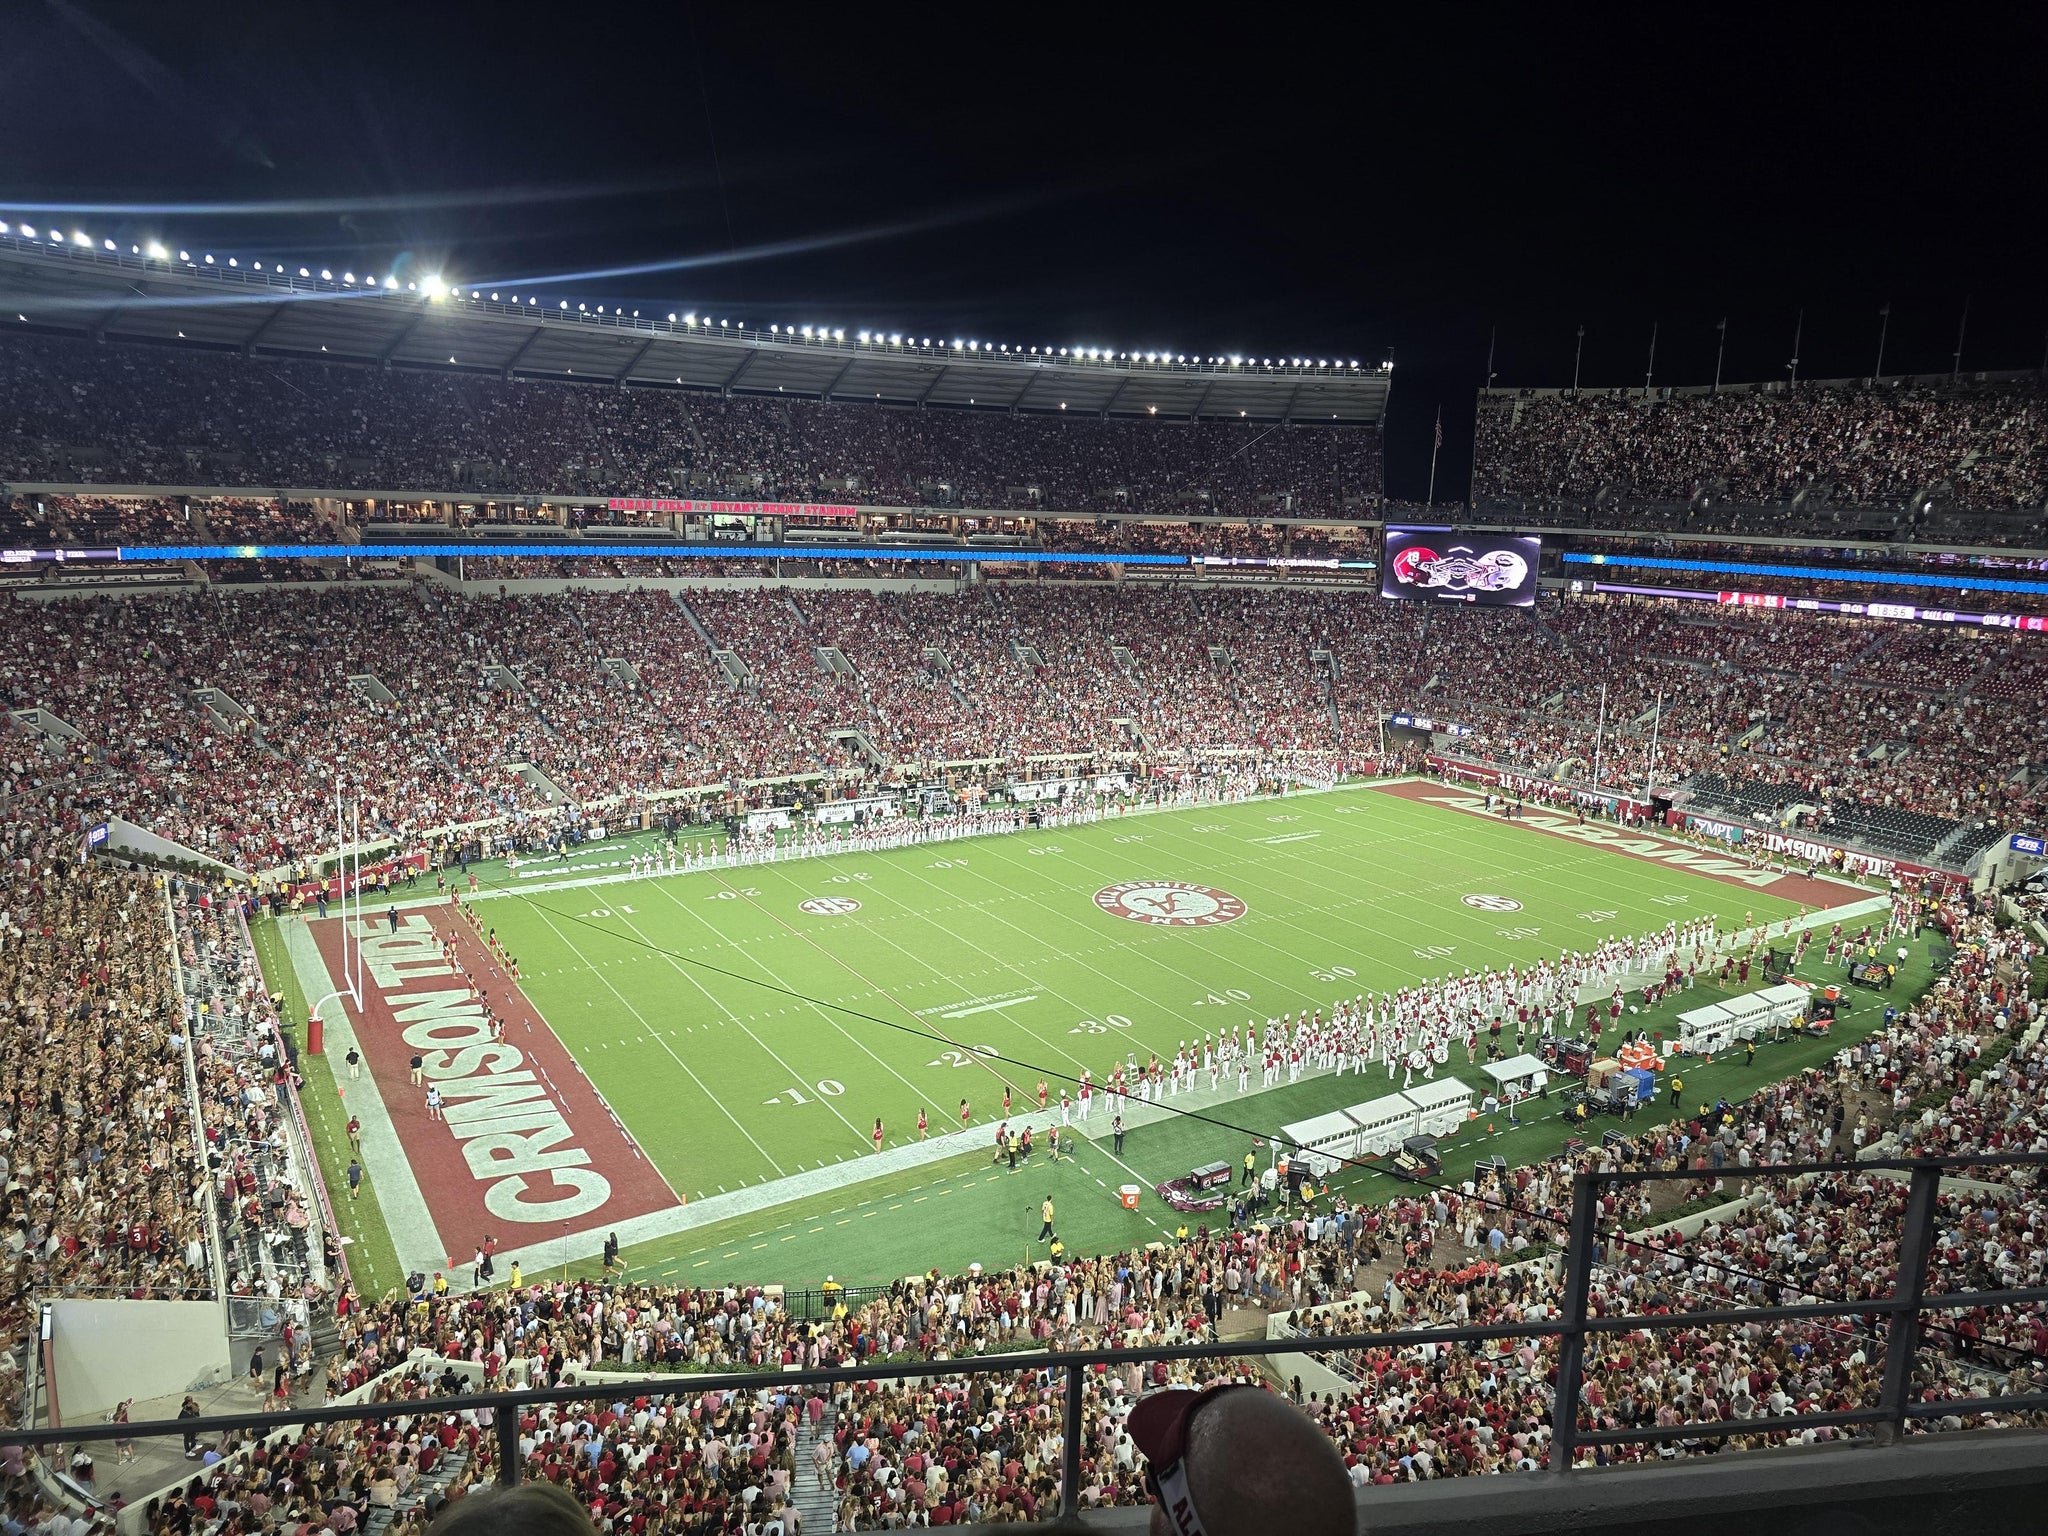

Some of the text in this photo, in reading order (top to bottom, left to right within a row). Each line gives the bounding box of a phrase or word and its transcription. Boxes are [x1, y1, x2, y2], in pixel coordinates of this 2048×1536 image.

[608, 499, 653, 510] SABAN
[656, 500, 692, 511] FIELD
[710, 502, 800, 514] BRYANT-DENNY
[803, 505, 857, 517] STADIUM
[1420, 796, 1787, 887] ALABAMA
[1496, 926, 1540, 941] 30
[346, 914, 461, 989] TIDE
[1412, 945, 1454, 961] 40
[1309, 966, 1357, 982] 50
[1206, 988, 1252, 1007] 40
[1082, 1013, 1133, 1034] 30
[940, 1044, 1001, 1069] 20
[781, 1079, 847, 1106] 10
[384, 988, 612, 1223] CRIMSON
